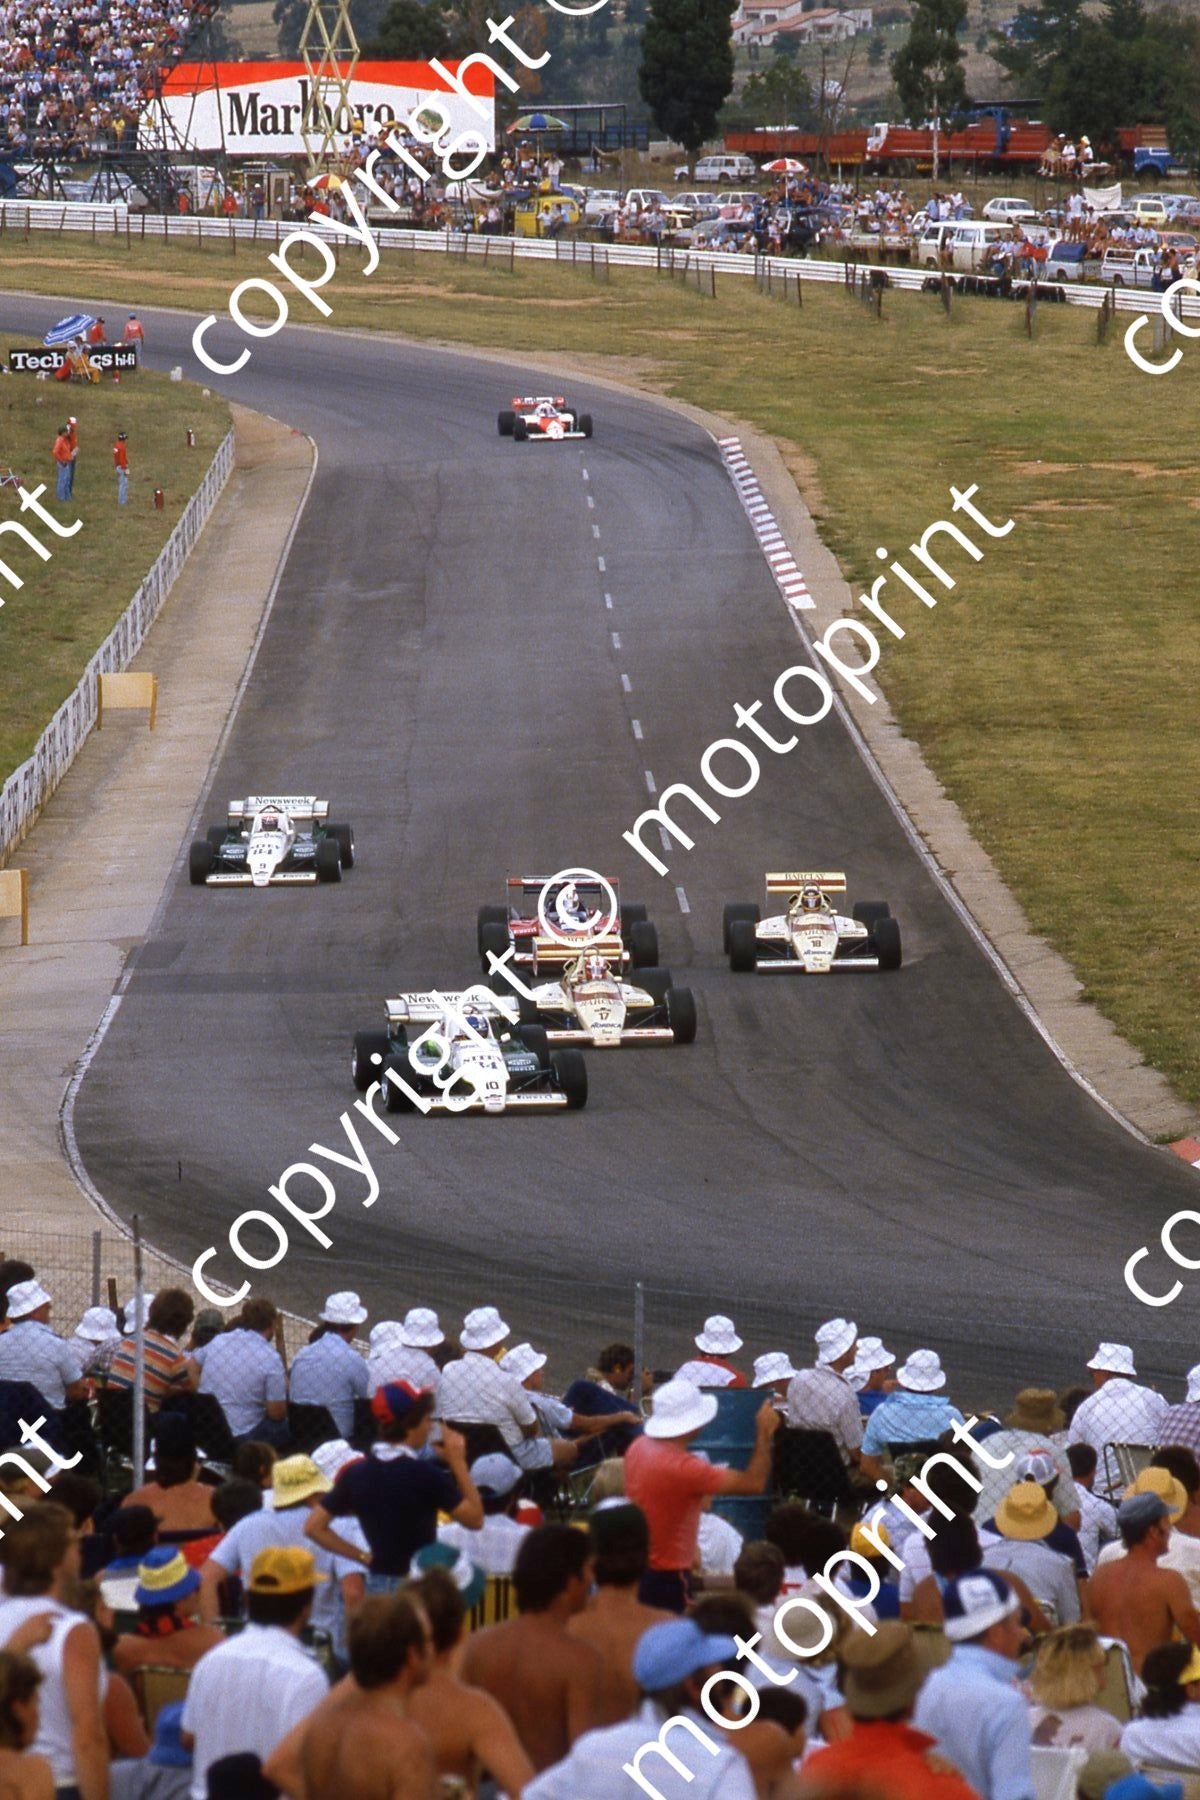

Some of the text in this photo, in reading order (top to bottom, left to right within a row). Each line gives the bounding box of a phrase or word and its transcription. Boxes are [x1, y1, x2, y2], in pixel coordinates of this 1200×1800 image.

[227, 79, 396, 136] Marlboro
[11, 351, 111, 370] Techcs
[255, 796, 310, 805] Newsweek
[599, 1012, 610, 1021] 17
[485, 1081, 499, 1090] 10
